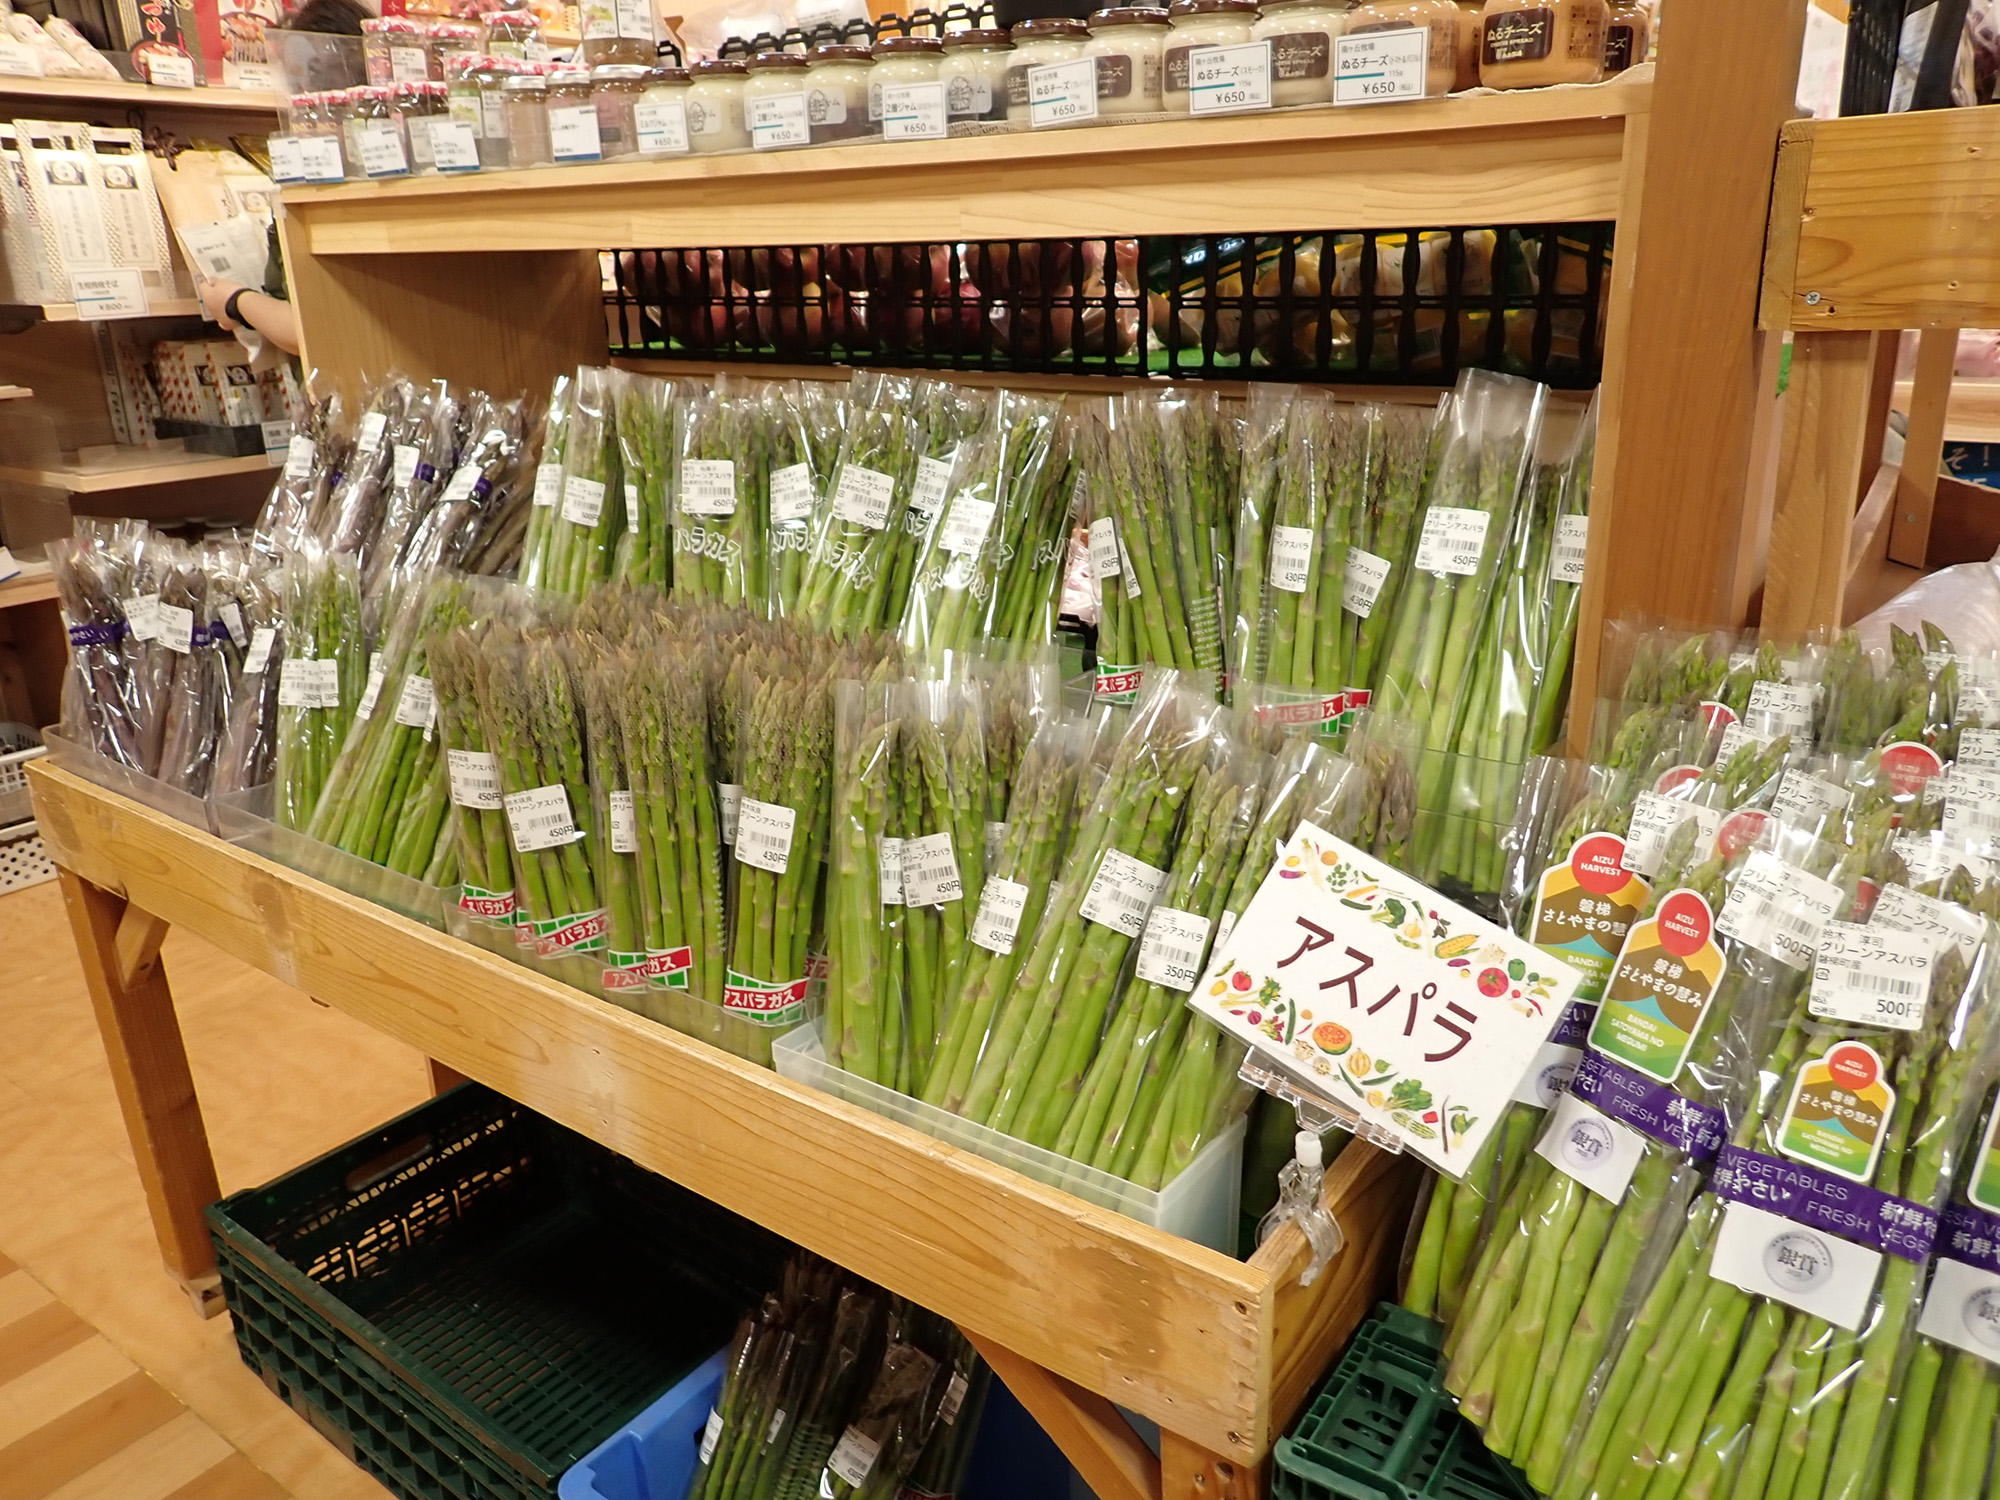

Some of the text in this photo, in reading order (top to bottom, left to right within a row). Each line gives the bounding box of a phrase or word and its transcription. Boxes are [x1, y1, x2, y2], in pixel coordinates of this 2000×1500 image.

[1487, 22, 1544, 41] ぬるチーズ
[1341, 55, 1389, 70] ぬるチーズ
[1197, 65, 1239, 81] ぬるチーズ
[1036, 81, 1070, 96] ぬるチーズ
[1362, 81, 1395, 94] ¥650
[1216, 91, 1245, 104] ¥650
[1052, 103, 1076, 116] ¥650
[771, 131, 791, 140] ¥650
[903, 123, 926, 133] ¥650
[654, 137, 671, 146] ¥650
[1425, 519, 1484, 533] グリーンアスパラ
[1452, 554, 1479, 568] 450円
[508, 797, 565, 815] グリーンアスパラ
[741, 809, 791, 830] グリーンアスパラ
[549, 824, 574, 838] 450円
[763, 850, 787, 865] 430円
[1591, 854, 1615, 866] AIZU
[1101, 864, 1156, 893] グリーンアスパラ
[1580, 862, 1622, 877] HARVEST
[936, 879, 961, 894] 450円
[1743, 868, 1832, 915] グリーンアスパラ
[1578, 898, 1612, 917] 磐梯
[1119, 912, 1144, 931] 450円
[1674, 912, 1695, 926] AIZU
[1877, 903, 1975, 947] グリーンアスパラ
[989, 929, 1014, 947] 450円
[1664, 920, 1700, 939] HARVEST
[1774, 932, 1815, 963] 500円
[1820, 941, 1928, 969] グリーンアスパラ
[1165, 964, 1197, 984] 350円
[1652, 957, 1684, 980] 磐梯
[1277, 915, 1477, 1063] アスパラ
[1619, 964, 1702, 1009] さとやまの恵み
[1876, 999, 1924, 1019] 500円
[1626, 1013, 1658, 1033] BANDAI
[1610, 1018, 1665, 1049] SATOYAMA NO
[1616, 1031, 1648, 1052] MEGUMI
[1611, 1095, 1658, 1127] FRESH
[1800, 1092, 1878, 1128] さとやまの恵み
[1726, 1153, 1849, 1201] VEGETABLES
[1806, 1201, 1872, 1233] FRESH
